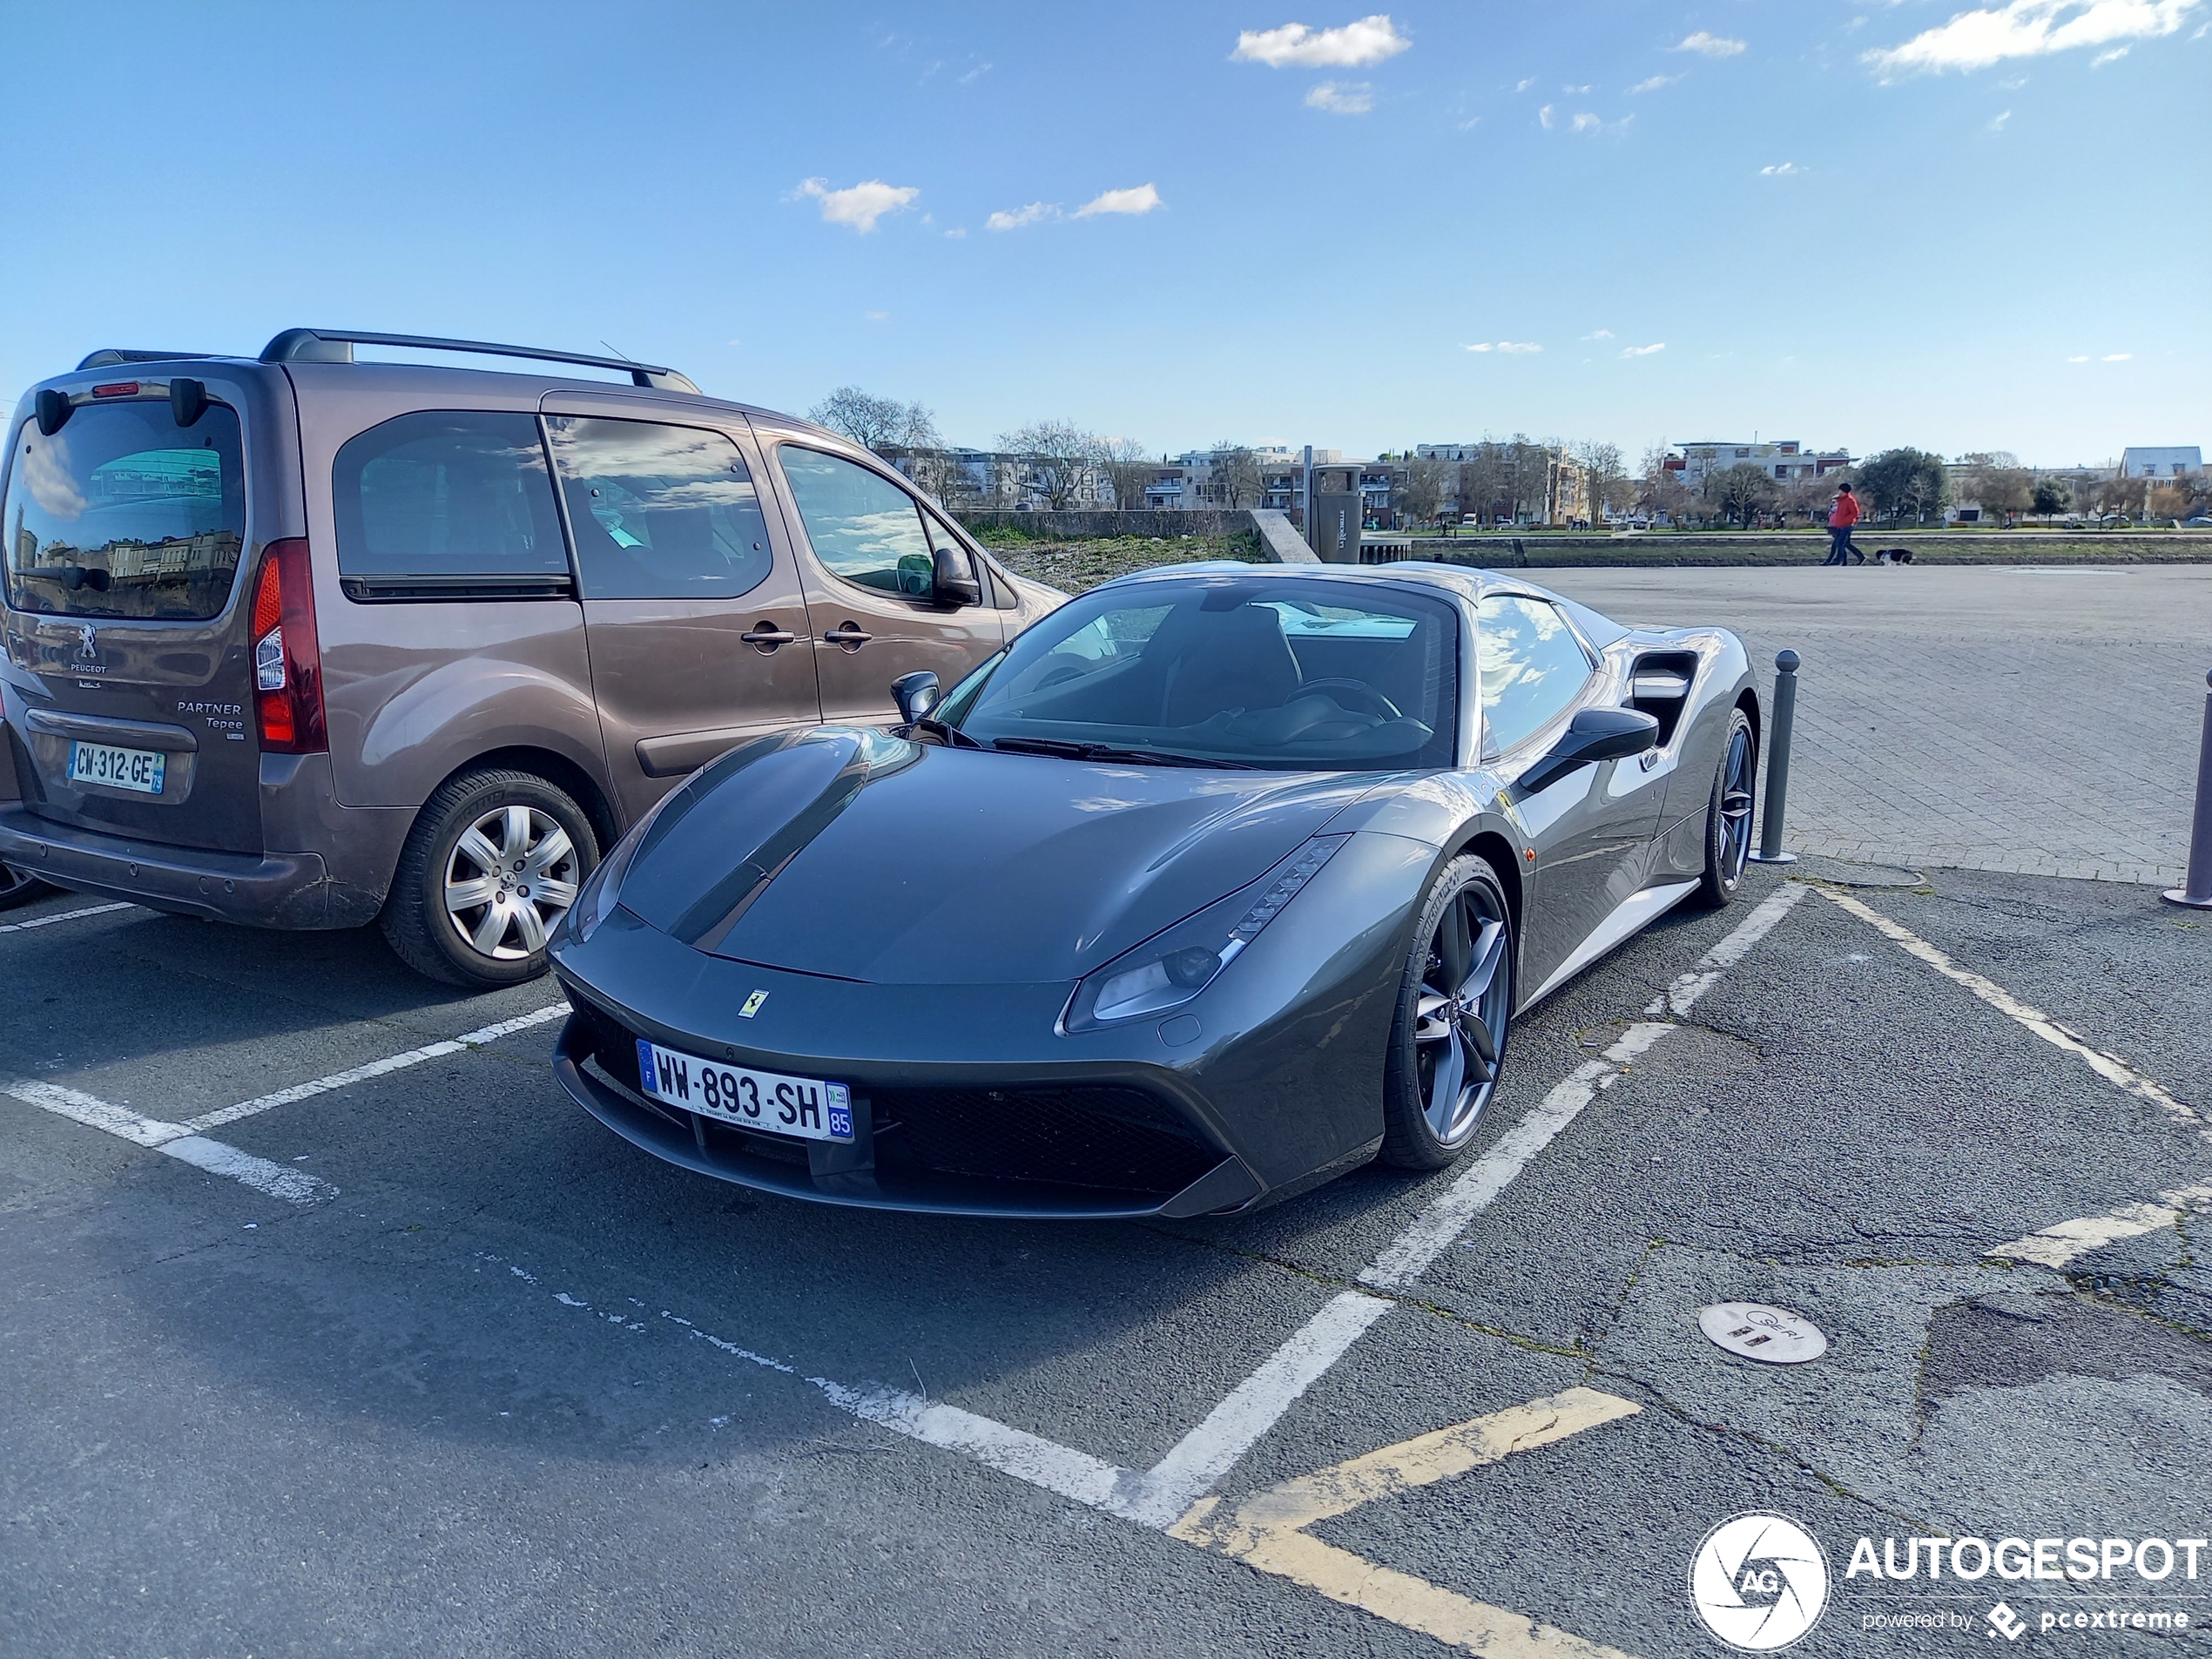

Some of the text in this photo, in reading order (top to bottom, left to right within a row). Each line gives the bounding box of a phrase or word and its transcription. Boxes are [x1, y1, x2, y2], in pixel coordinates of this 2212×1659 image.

[1339, 540, 1345, 549] LA
[71, 664, 107, 674] PEUGEOT
[178, 701, 242, 715] PARTNER
[206, 717, 243, 731] Tepee
[152, 774, 162, 789] 79
[645, 1069, 651, 1083] F
[655, 1051, 821, 1130] WW-893-SH
[830, 1112, 851, 1134] 85
[1759, 1318, 1805, 1341] SERI
